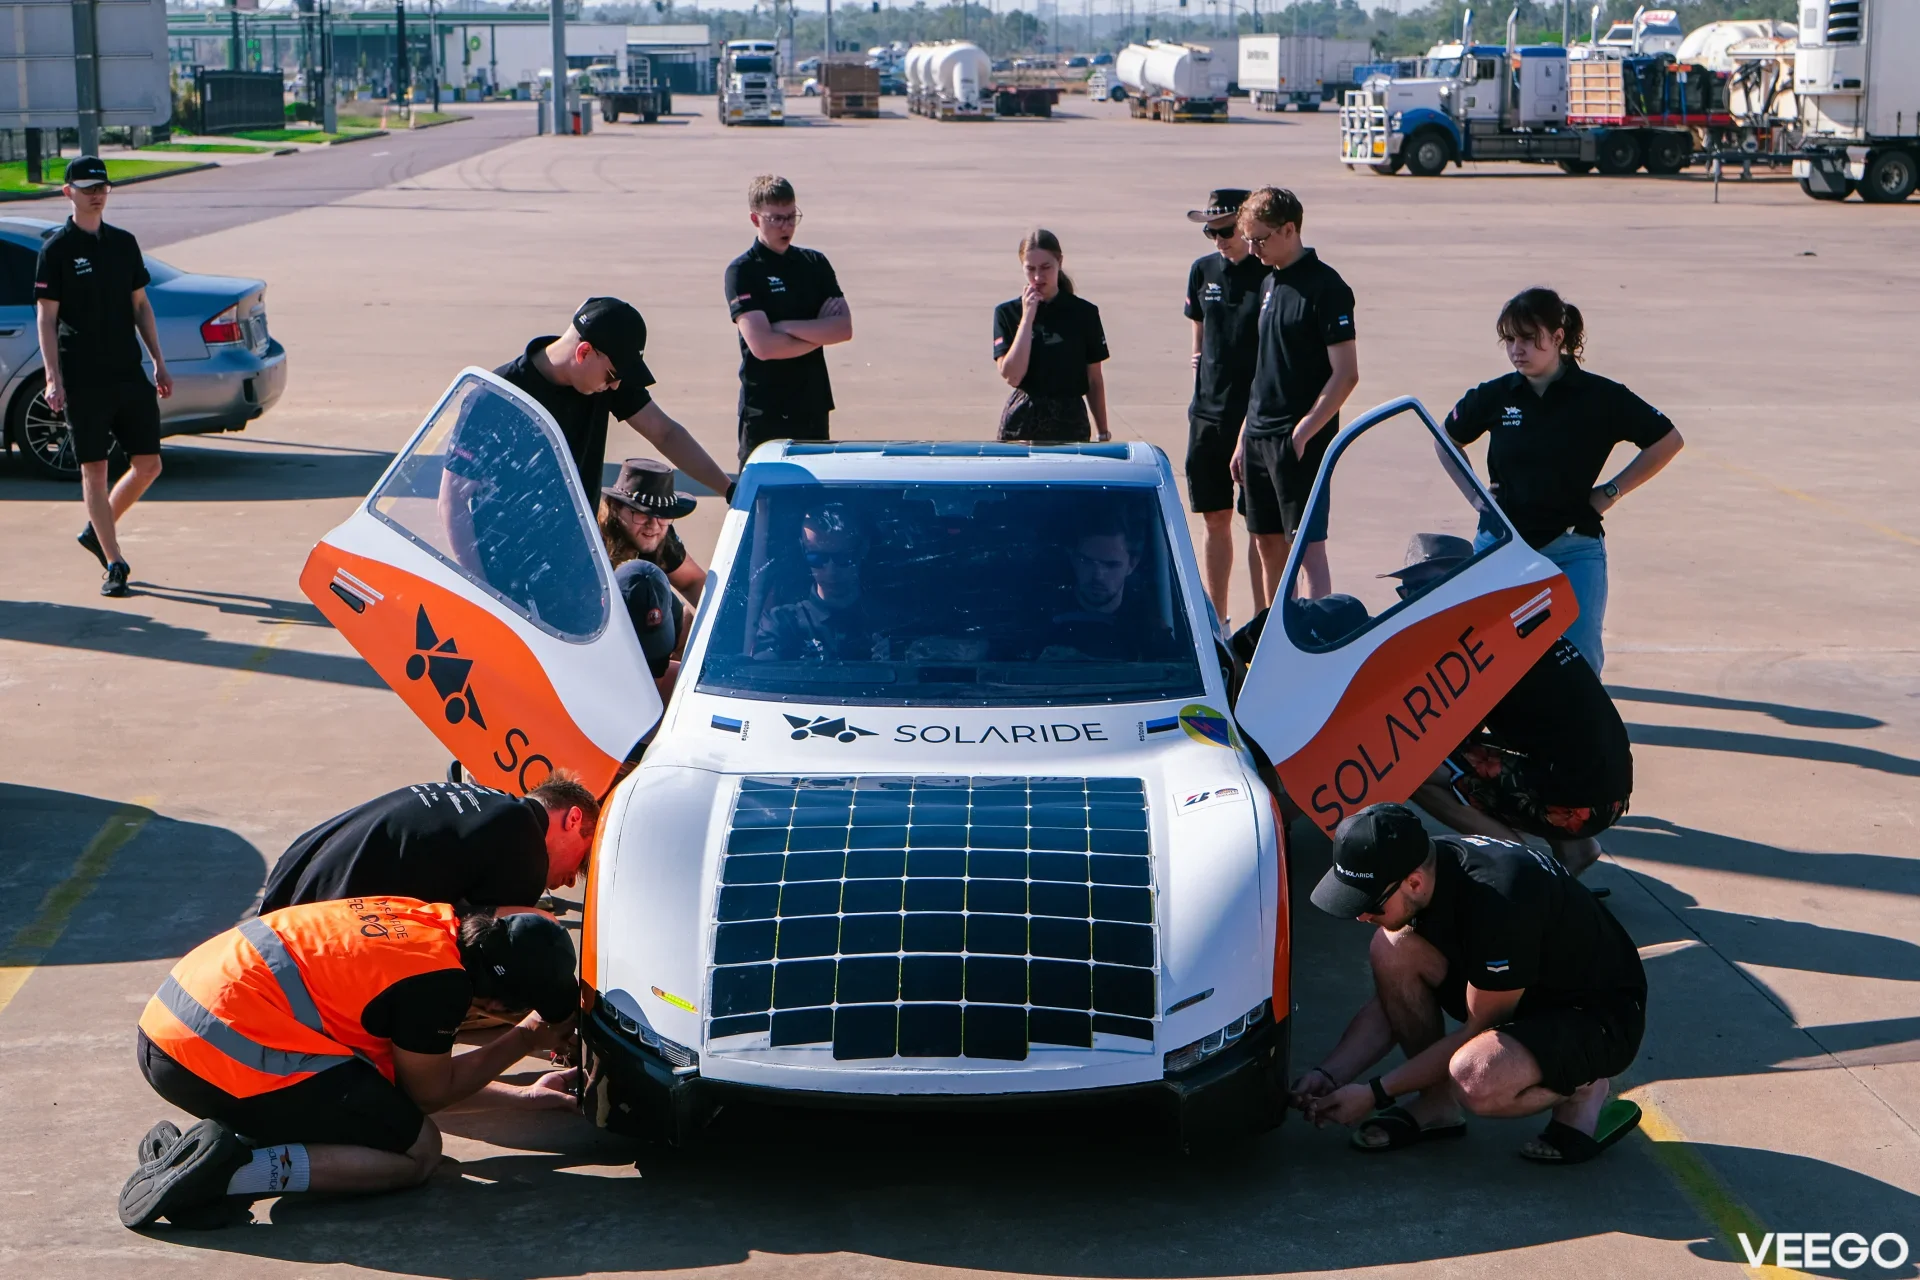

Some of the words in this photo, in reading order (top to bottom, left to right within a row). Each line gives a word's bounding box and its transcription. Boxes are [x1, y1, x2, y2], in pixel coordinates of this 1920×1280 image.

[741, 720, 750, 741] estonia
[893, 723, 1109, 744] SOLARIDE
[1136, 721, 1145, 741] estonia
[1311, 625, 1495, 832] SOLARIDE
[1345, 869, 1375, 879] SOLARIDE
